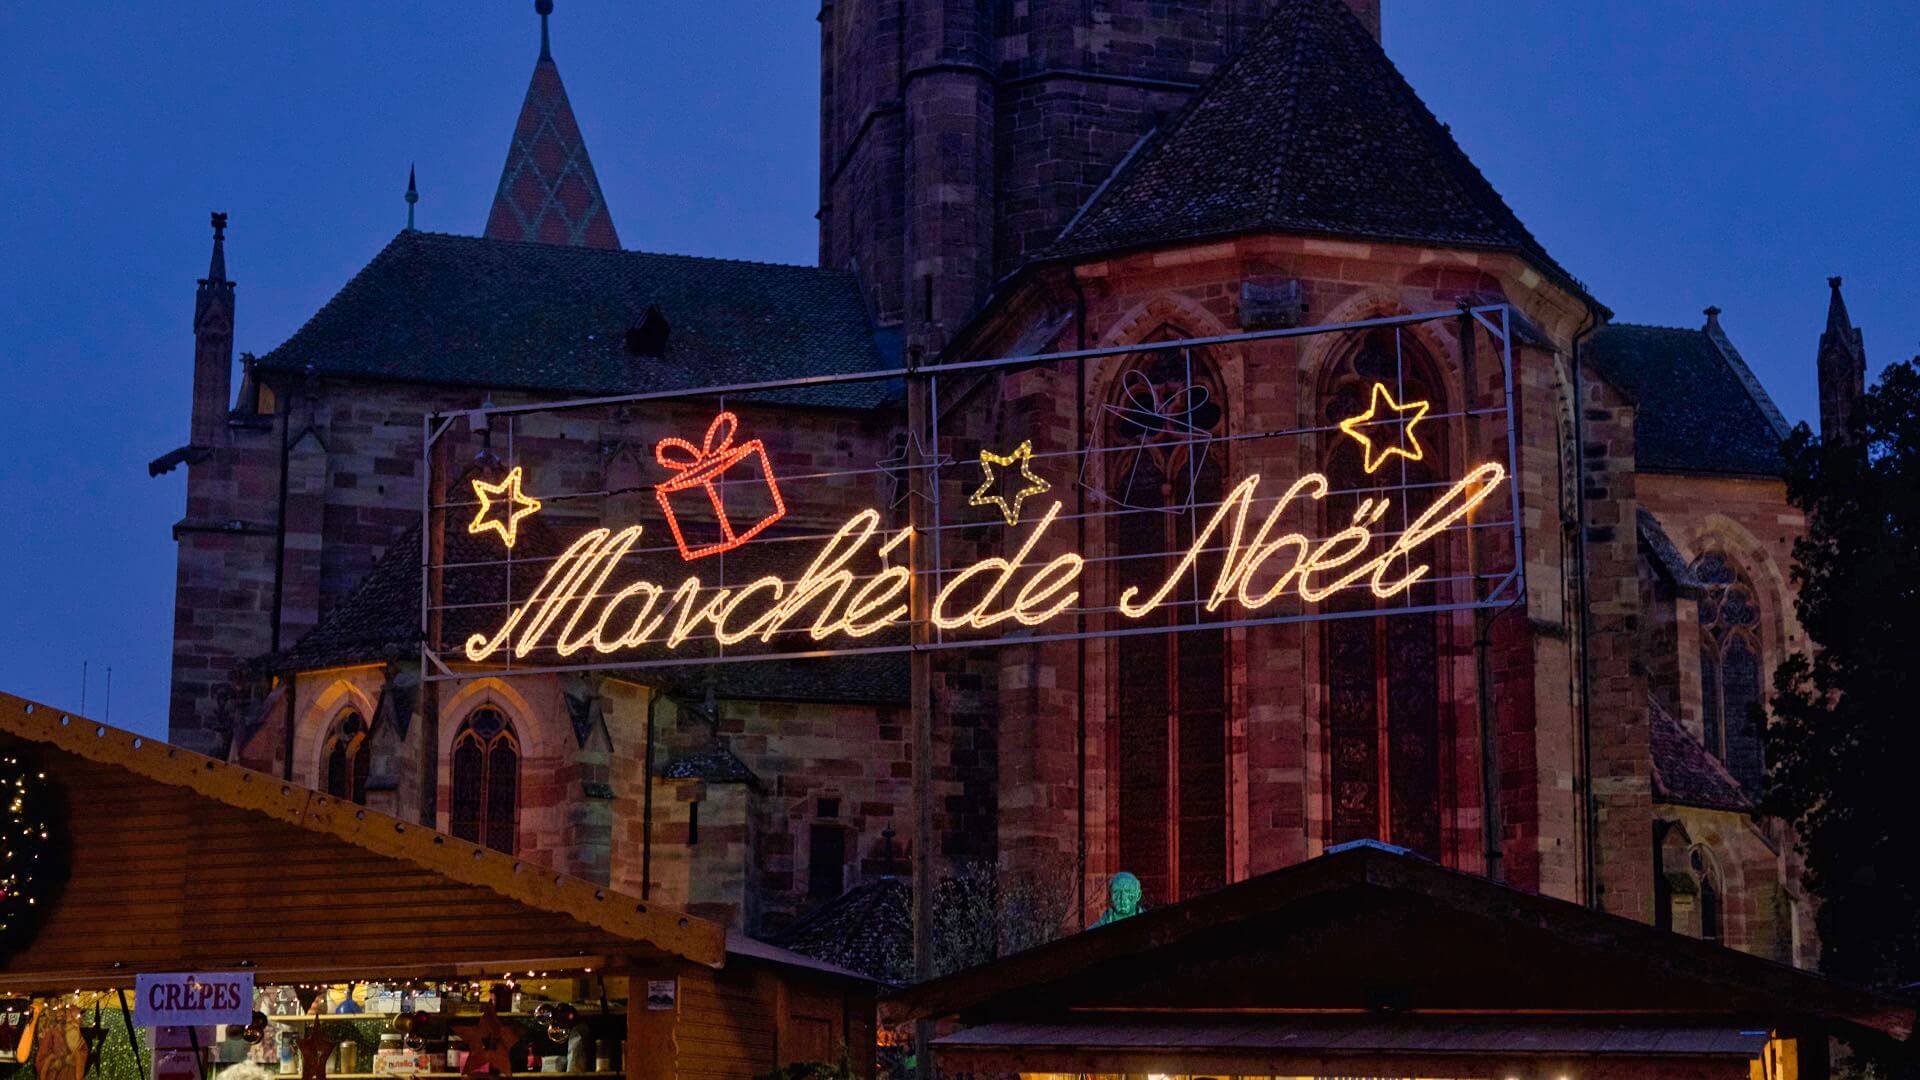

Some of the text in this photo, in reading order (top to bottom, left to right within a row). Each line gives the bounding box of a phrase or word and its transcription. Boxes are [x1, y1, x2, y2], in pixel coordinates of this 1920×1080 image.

[465, 462, 1505, 661] Marché de Noël
[149, 975, 241, 1011] CRÊPES
